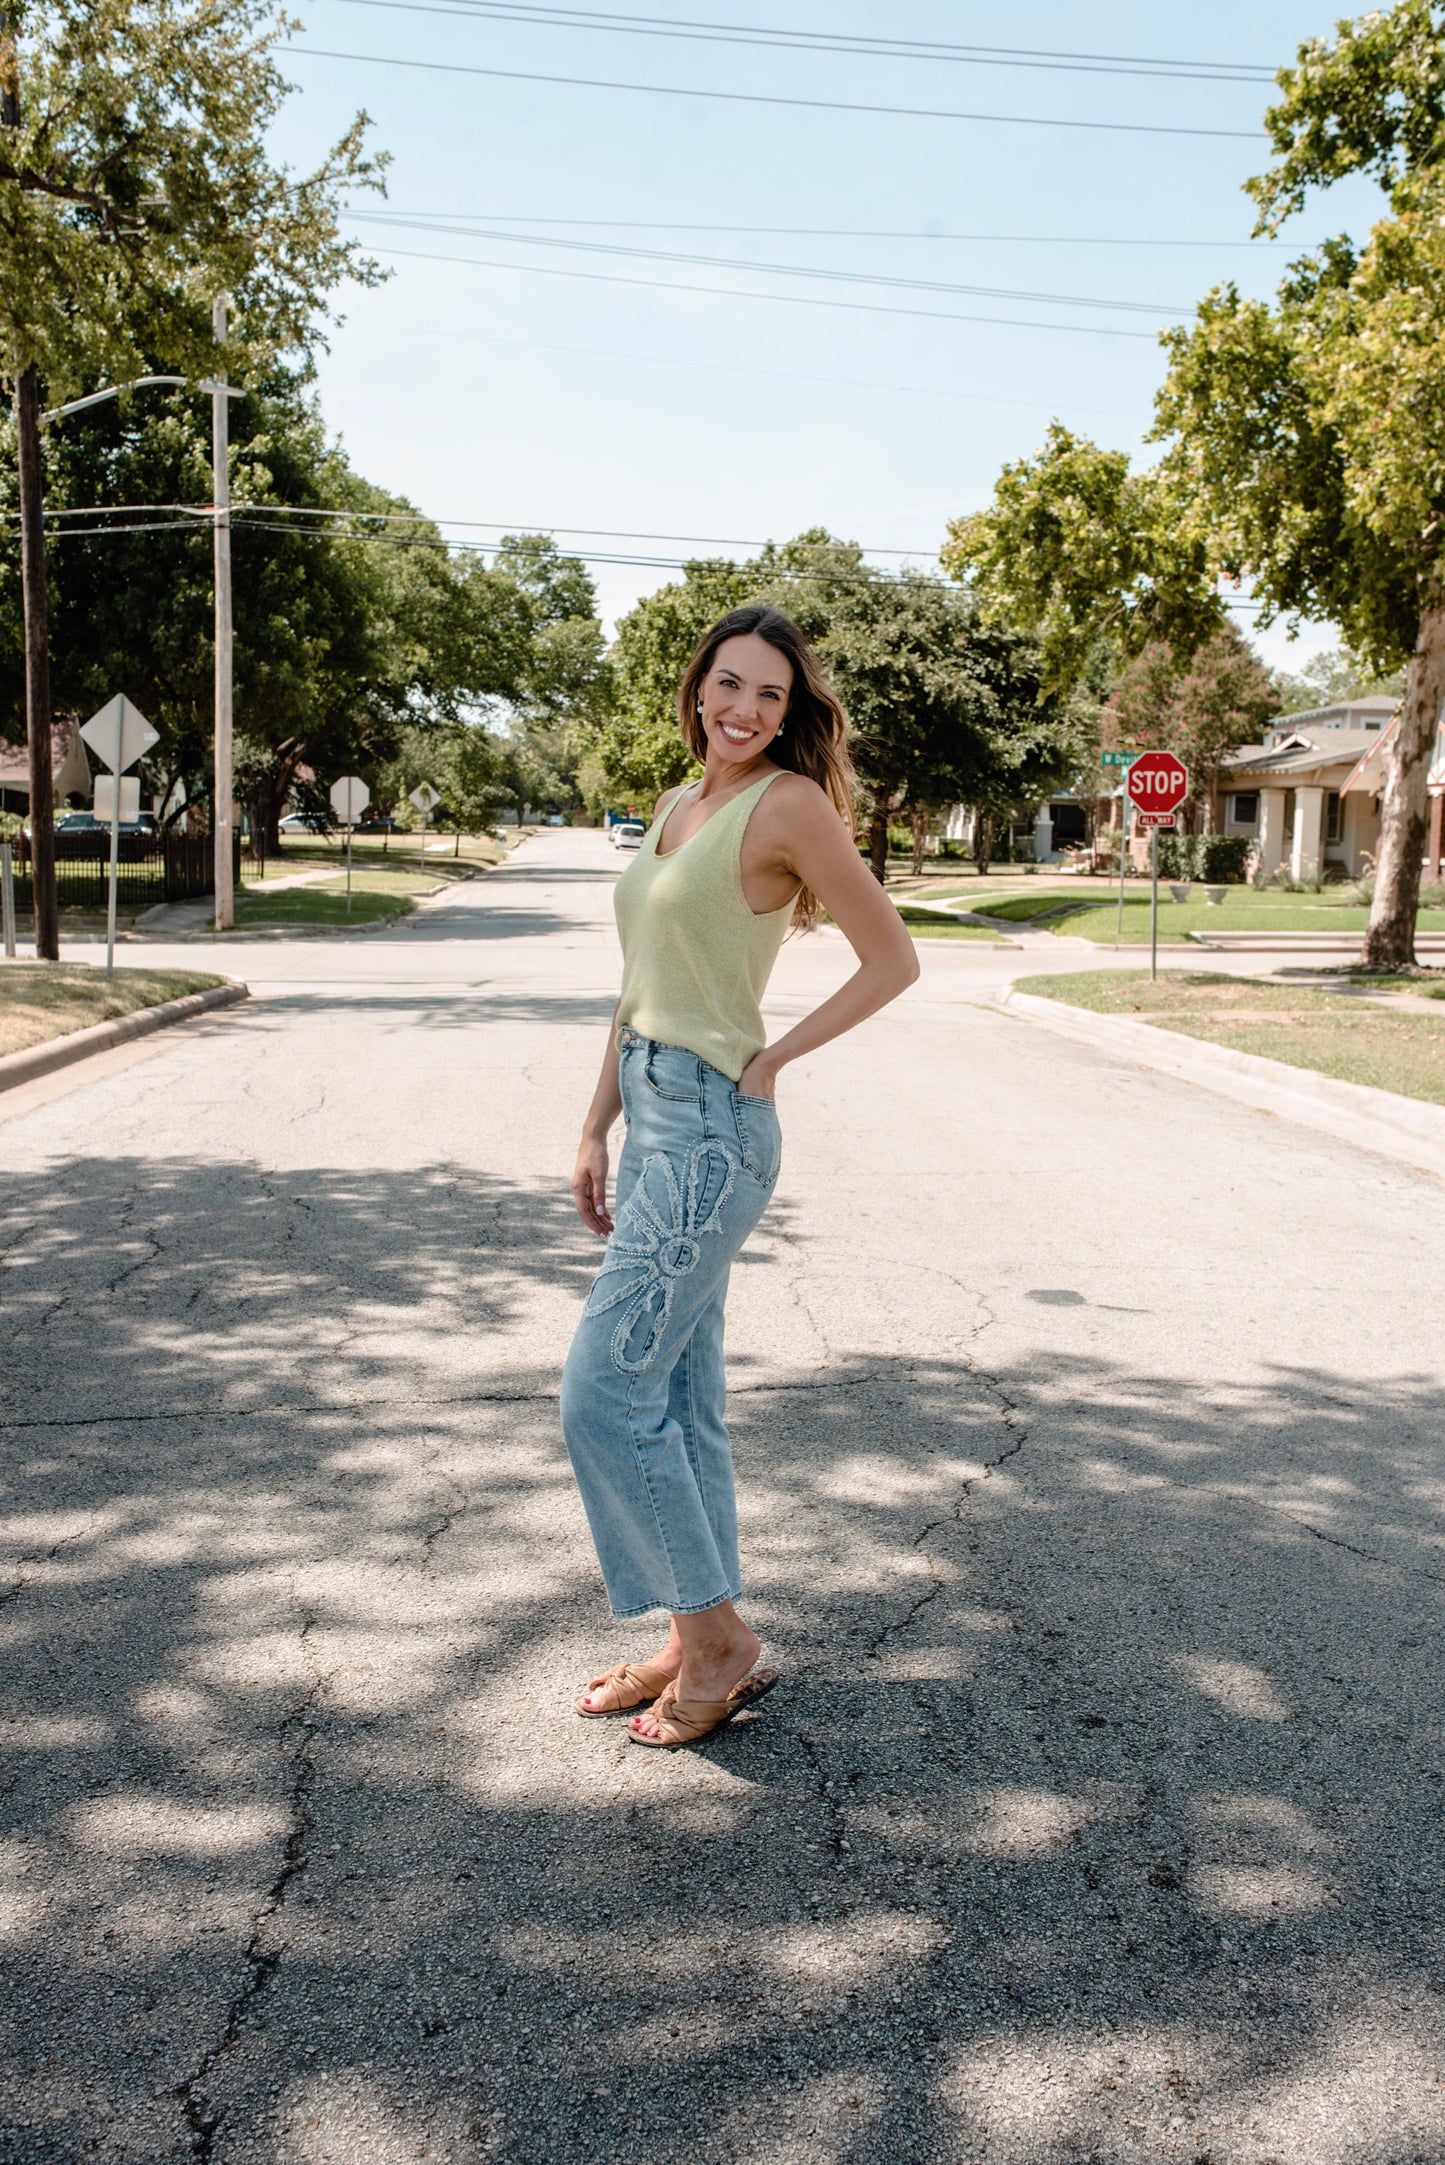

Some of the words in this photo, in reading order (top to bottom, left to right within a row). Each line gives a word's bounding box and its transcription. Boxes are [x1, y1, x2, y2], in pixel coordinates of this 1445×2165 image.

[1104, 753, 1112, 764] W
[1131, 771, 1184, 794] STOP
[1142, 816, 1154, 824] ALL
[1157, 816, 1172, 824] WAY
